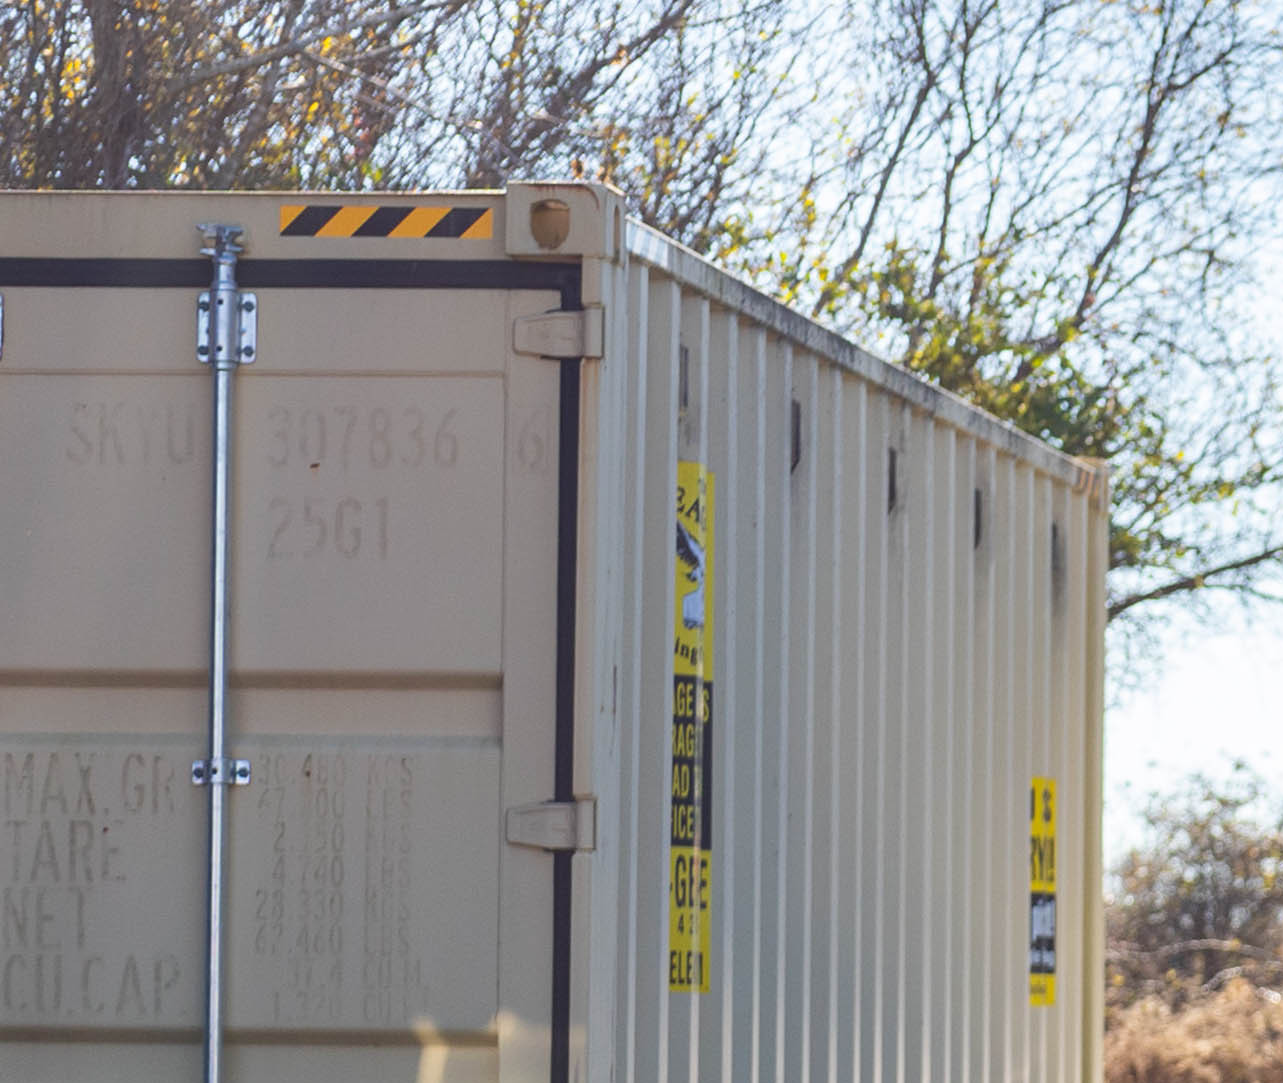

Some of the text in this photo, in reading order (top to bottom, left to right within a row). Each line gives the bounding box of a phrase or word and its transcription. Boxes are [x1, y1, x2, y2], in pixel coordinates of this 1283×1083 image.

[265, 406, 460, 471] 307836
[265, 495, 391, 561] 25G1
[4, 819, 127, 885] TARE
[3, 887, 90, 951] NET
